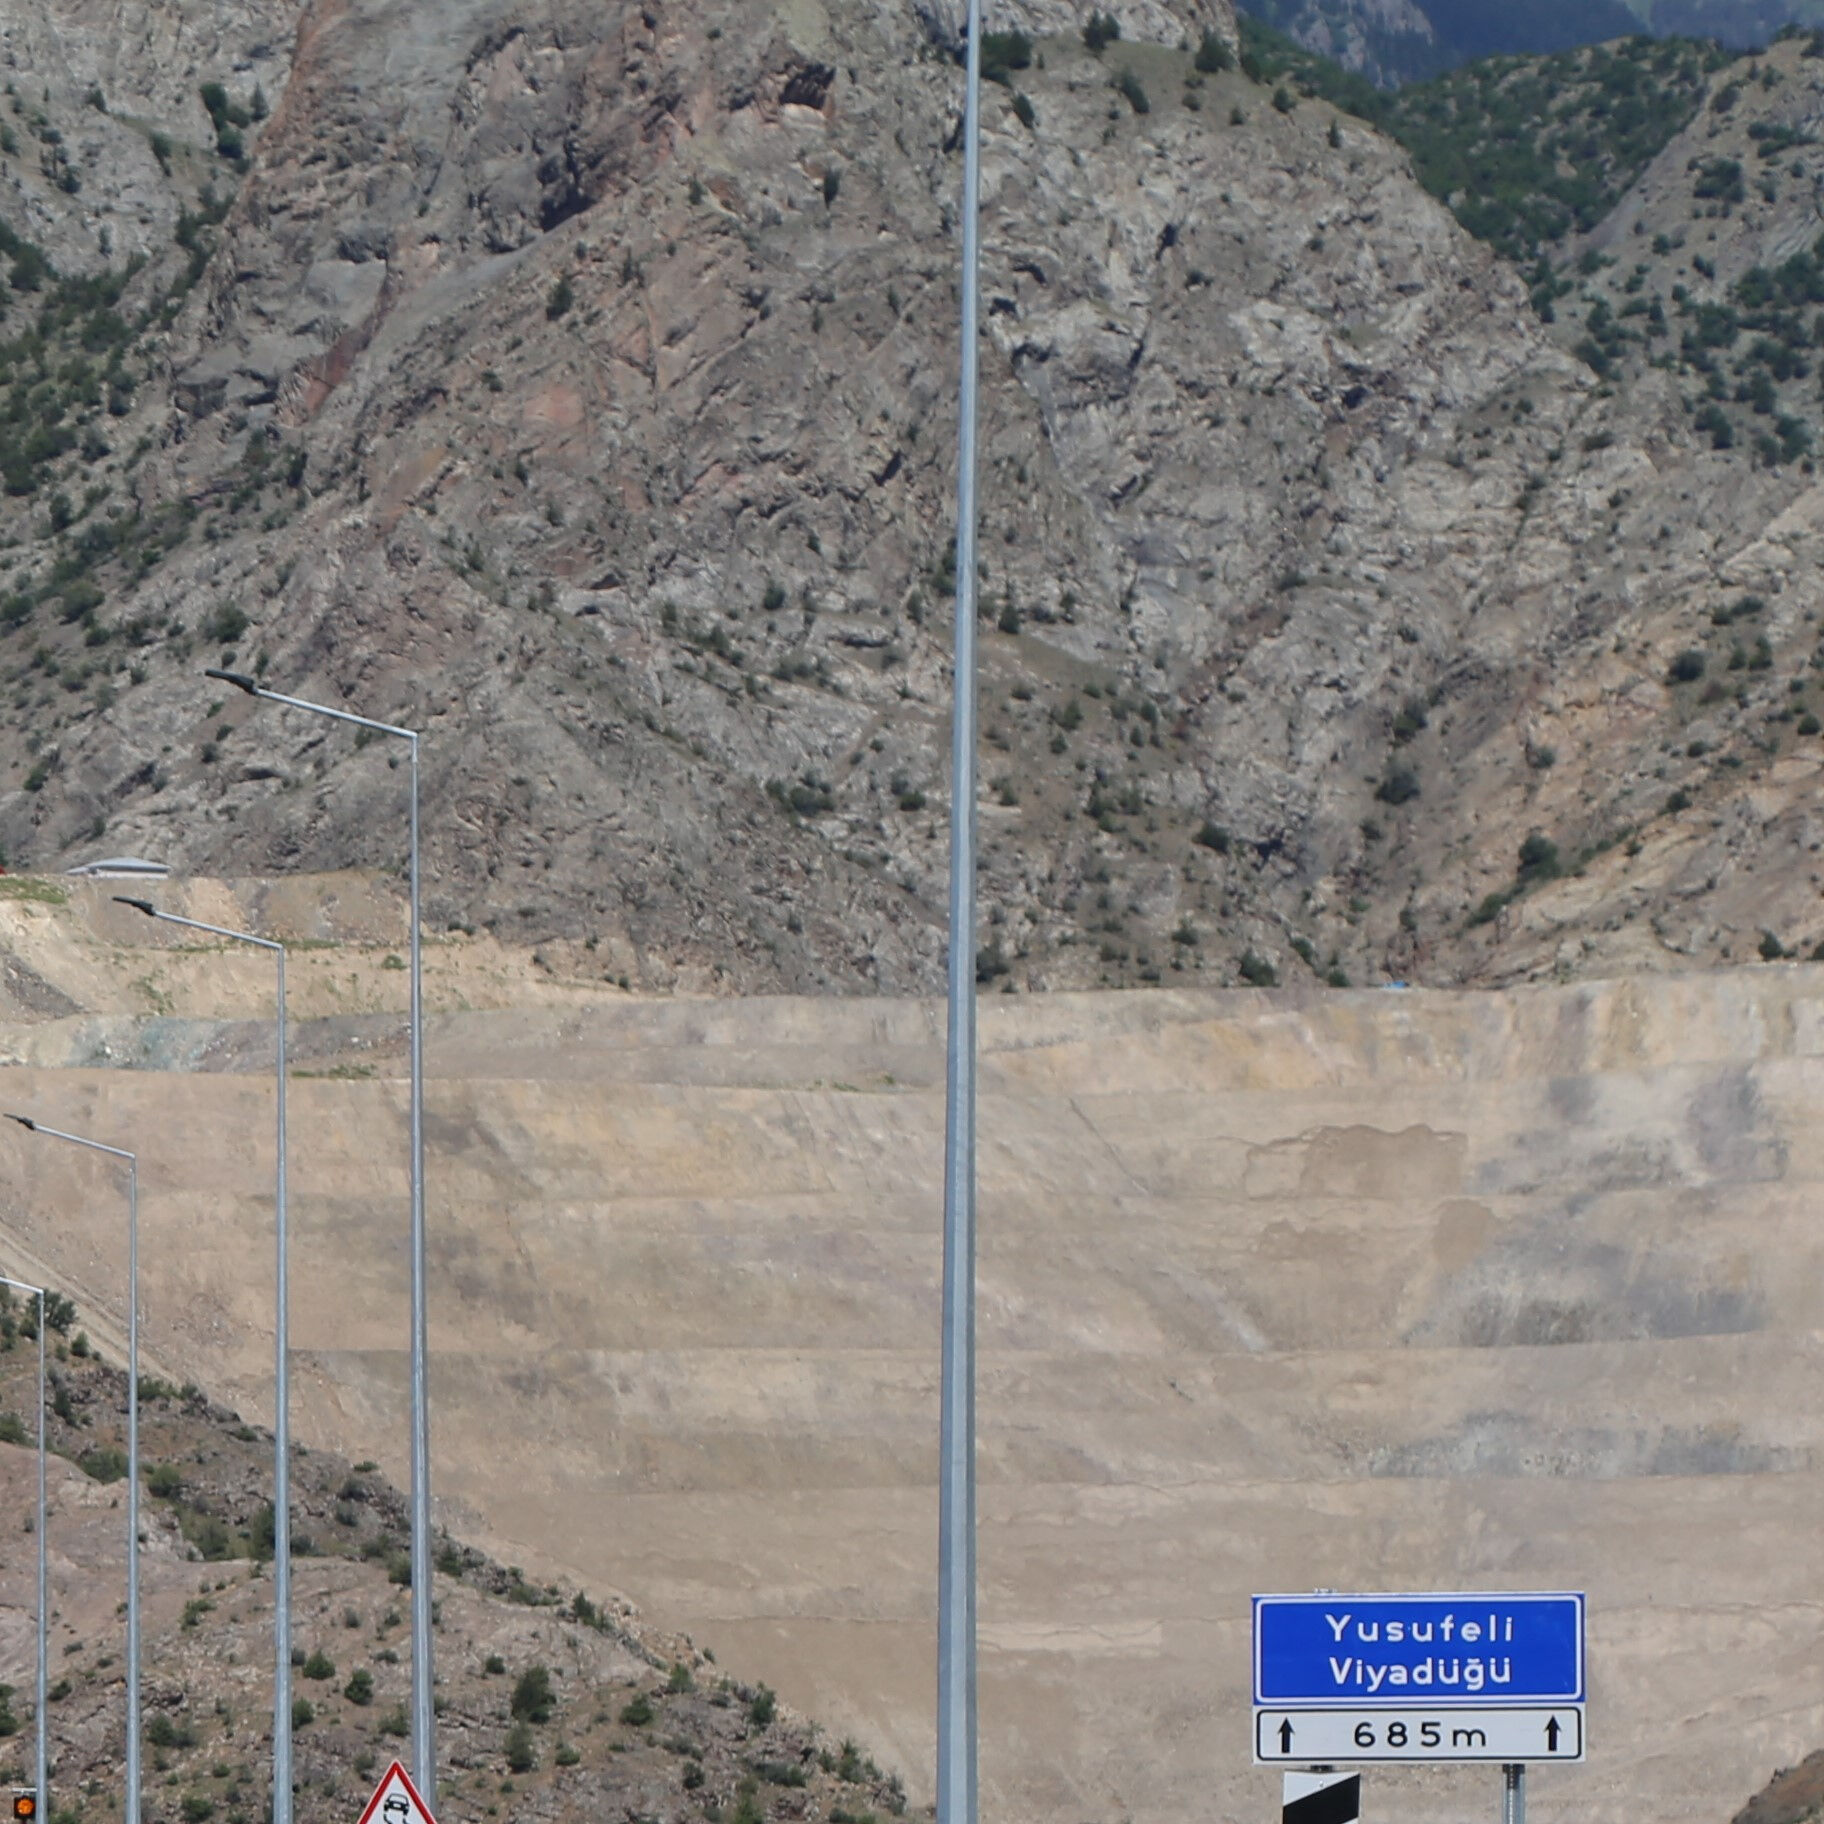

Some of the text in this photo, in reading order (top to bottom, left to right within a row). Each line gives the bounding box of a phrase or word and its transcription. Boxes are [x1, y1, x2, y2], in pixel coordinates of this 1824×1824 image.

[1325, 1614, 1513, 1642] Yusufeli
[1329, 1657, 1511, 1691] Viyadüğü
[1354, 1721, 1486, 1748] 685 m
